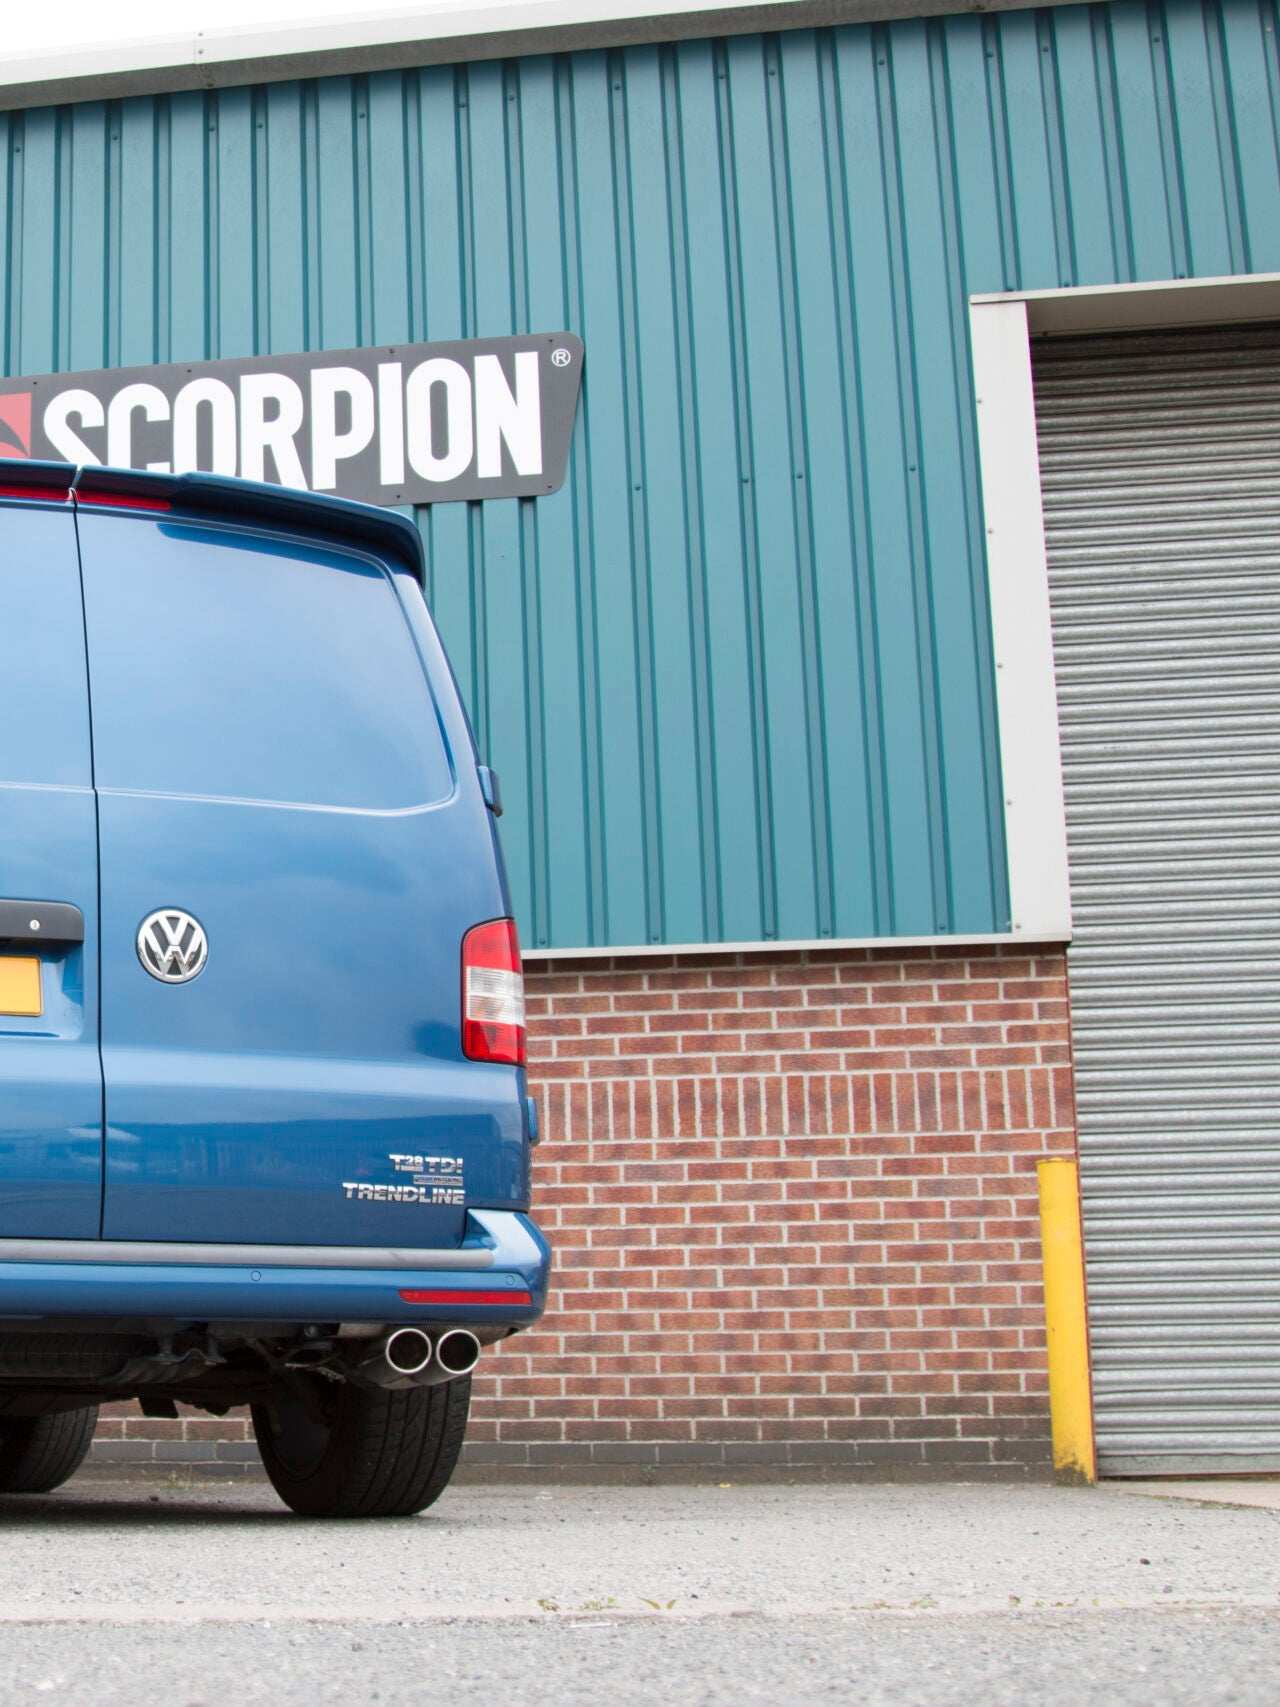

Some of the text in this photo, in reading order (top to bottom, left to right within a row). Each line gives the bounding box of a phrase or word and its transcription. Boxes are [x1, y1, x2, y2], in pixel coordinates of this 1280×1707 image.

[43, 351, 542, 491] SCORPION
[425, 1156, 464, 1174] TDI
[342, 1182, 466, 1205] TRENDLINE
